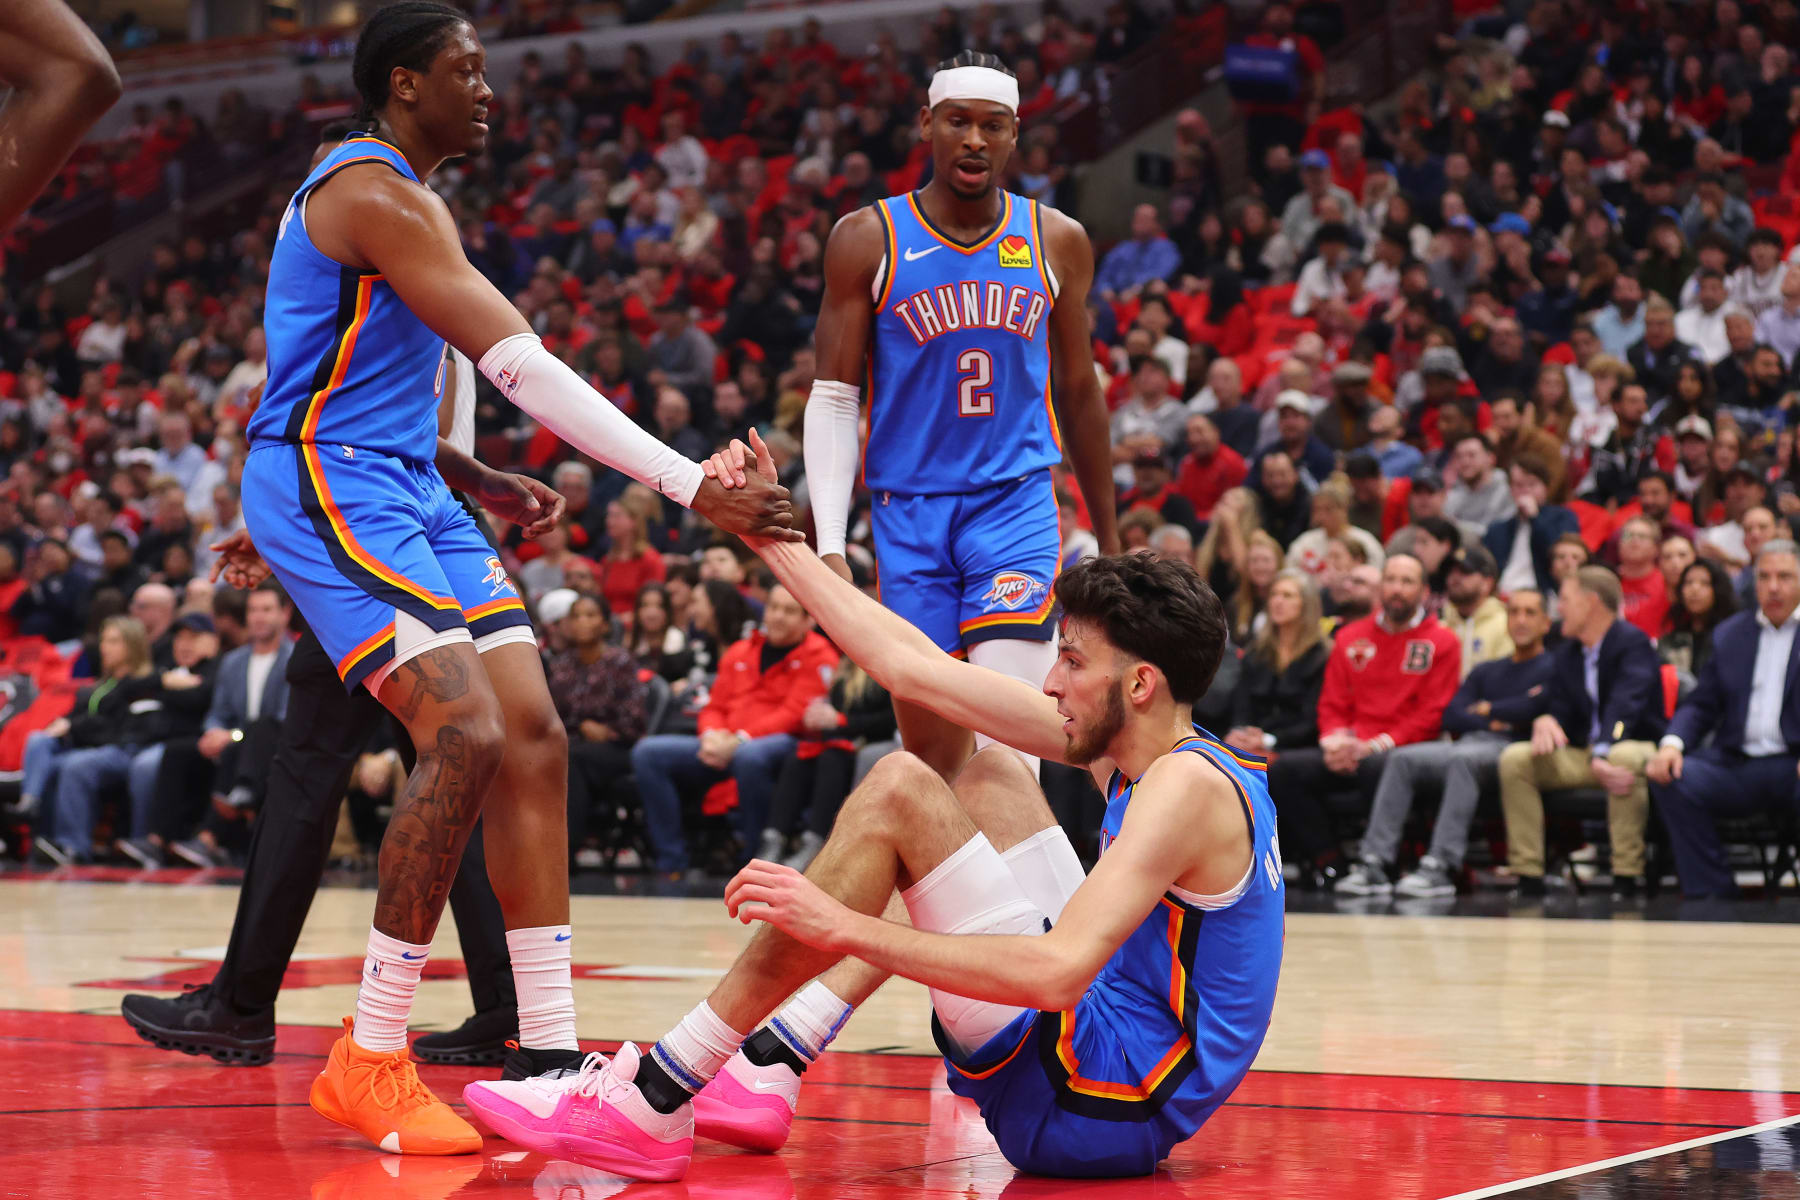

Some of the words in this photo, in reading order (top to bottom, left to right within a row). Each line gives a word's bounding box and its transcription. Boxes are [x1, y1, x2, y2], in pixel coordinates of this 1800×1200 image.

[893, 281, 1047, 345] THUNDER
[958, 349, 994, 416] 2
[993, 580, 1025, 602] OKC
[1401, 639, 1435, 674] B
